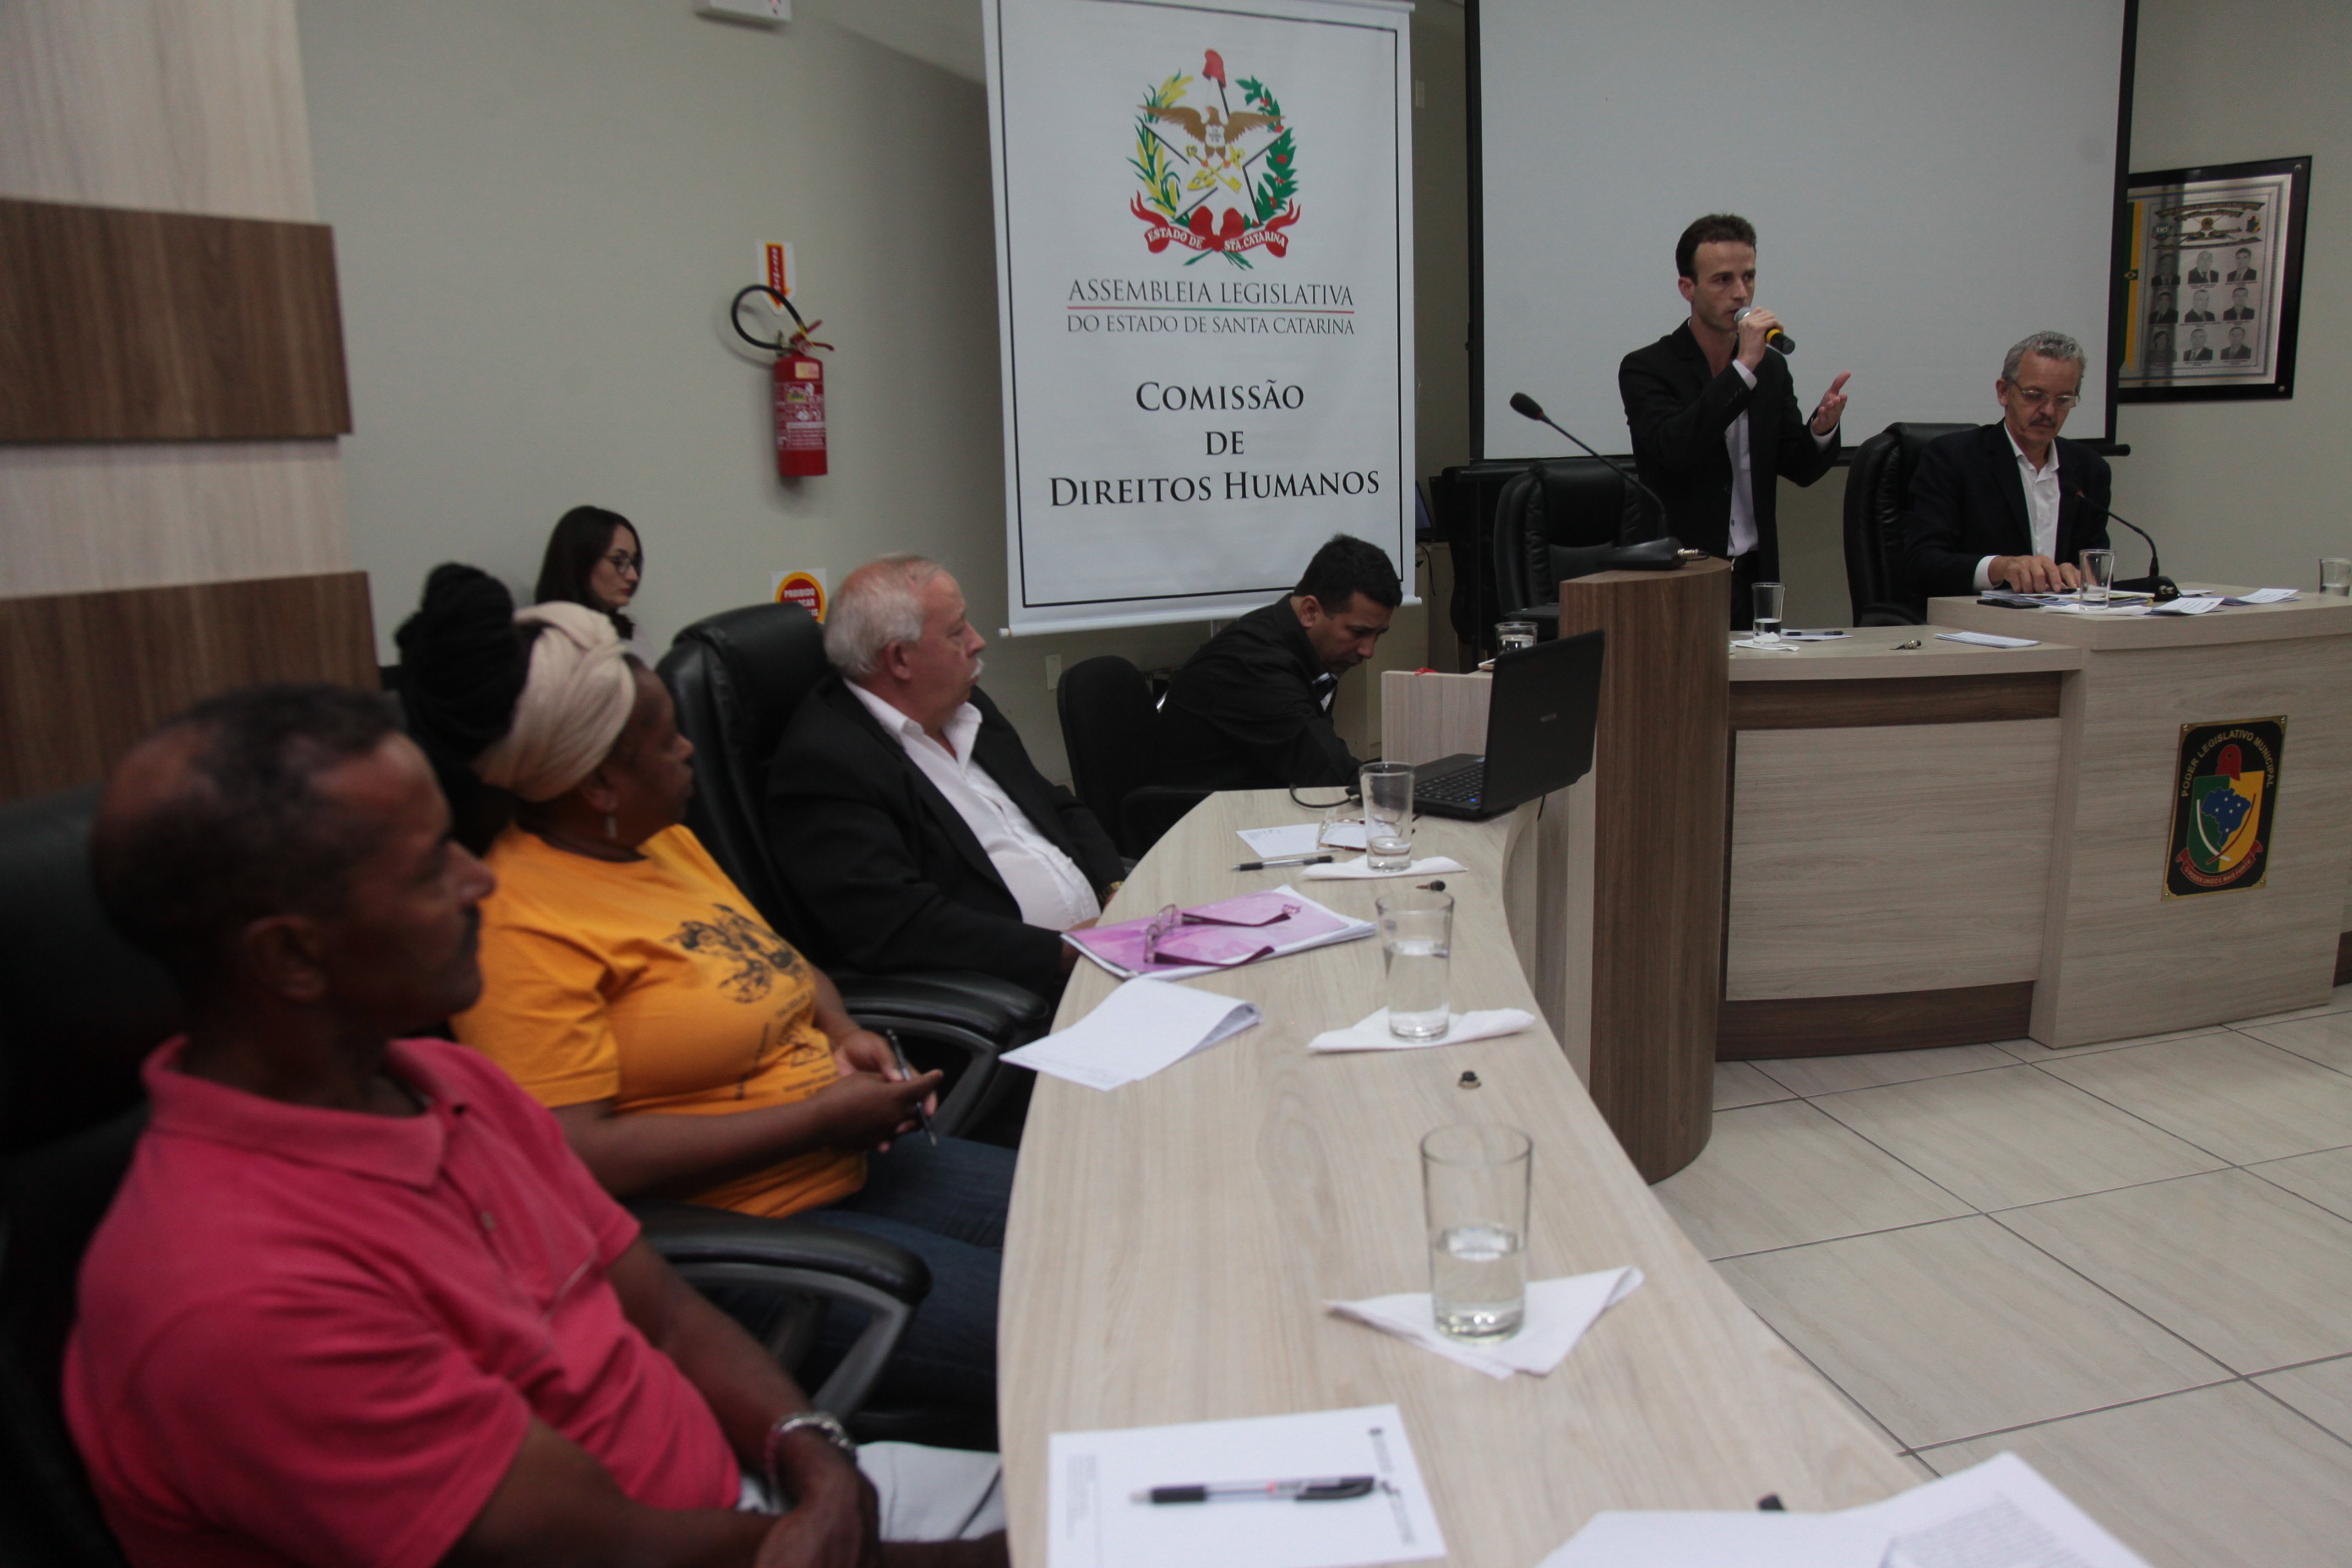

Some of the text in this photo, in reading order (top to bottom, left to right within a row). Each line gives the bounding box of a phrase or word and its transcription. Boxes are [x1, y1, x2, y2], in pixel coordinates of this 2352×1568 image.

[1147, 226, 1204, 249] ESTADO DE
[1068, 278, 1354, 306] ASSEMBLEIA LEGISLATIVA
[1067, 314, 1355, 335] DO ESTADO DE SANTA CATARINA
[1135, 379, 1304, 412] COMISSÃO
[1205, 431, 1244, 456] DE
[1049, 470, 1380, 508] DIREITOS HUMANOS
[2181, 729, 2275, 797] PODER LEGISLATIVO MUNICIPAL
[2188, 869, 2203, 883] PODER
